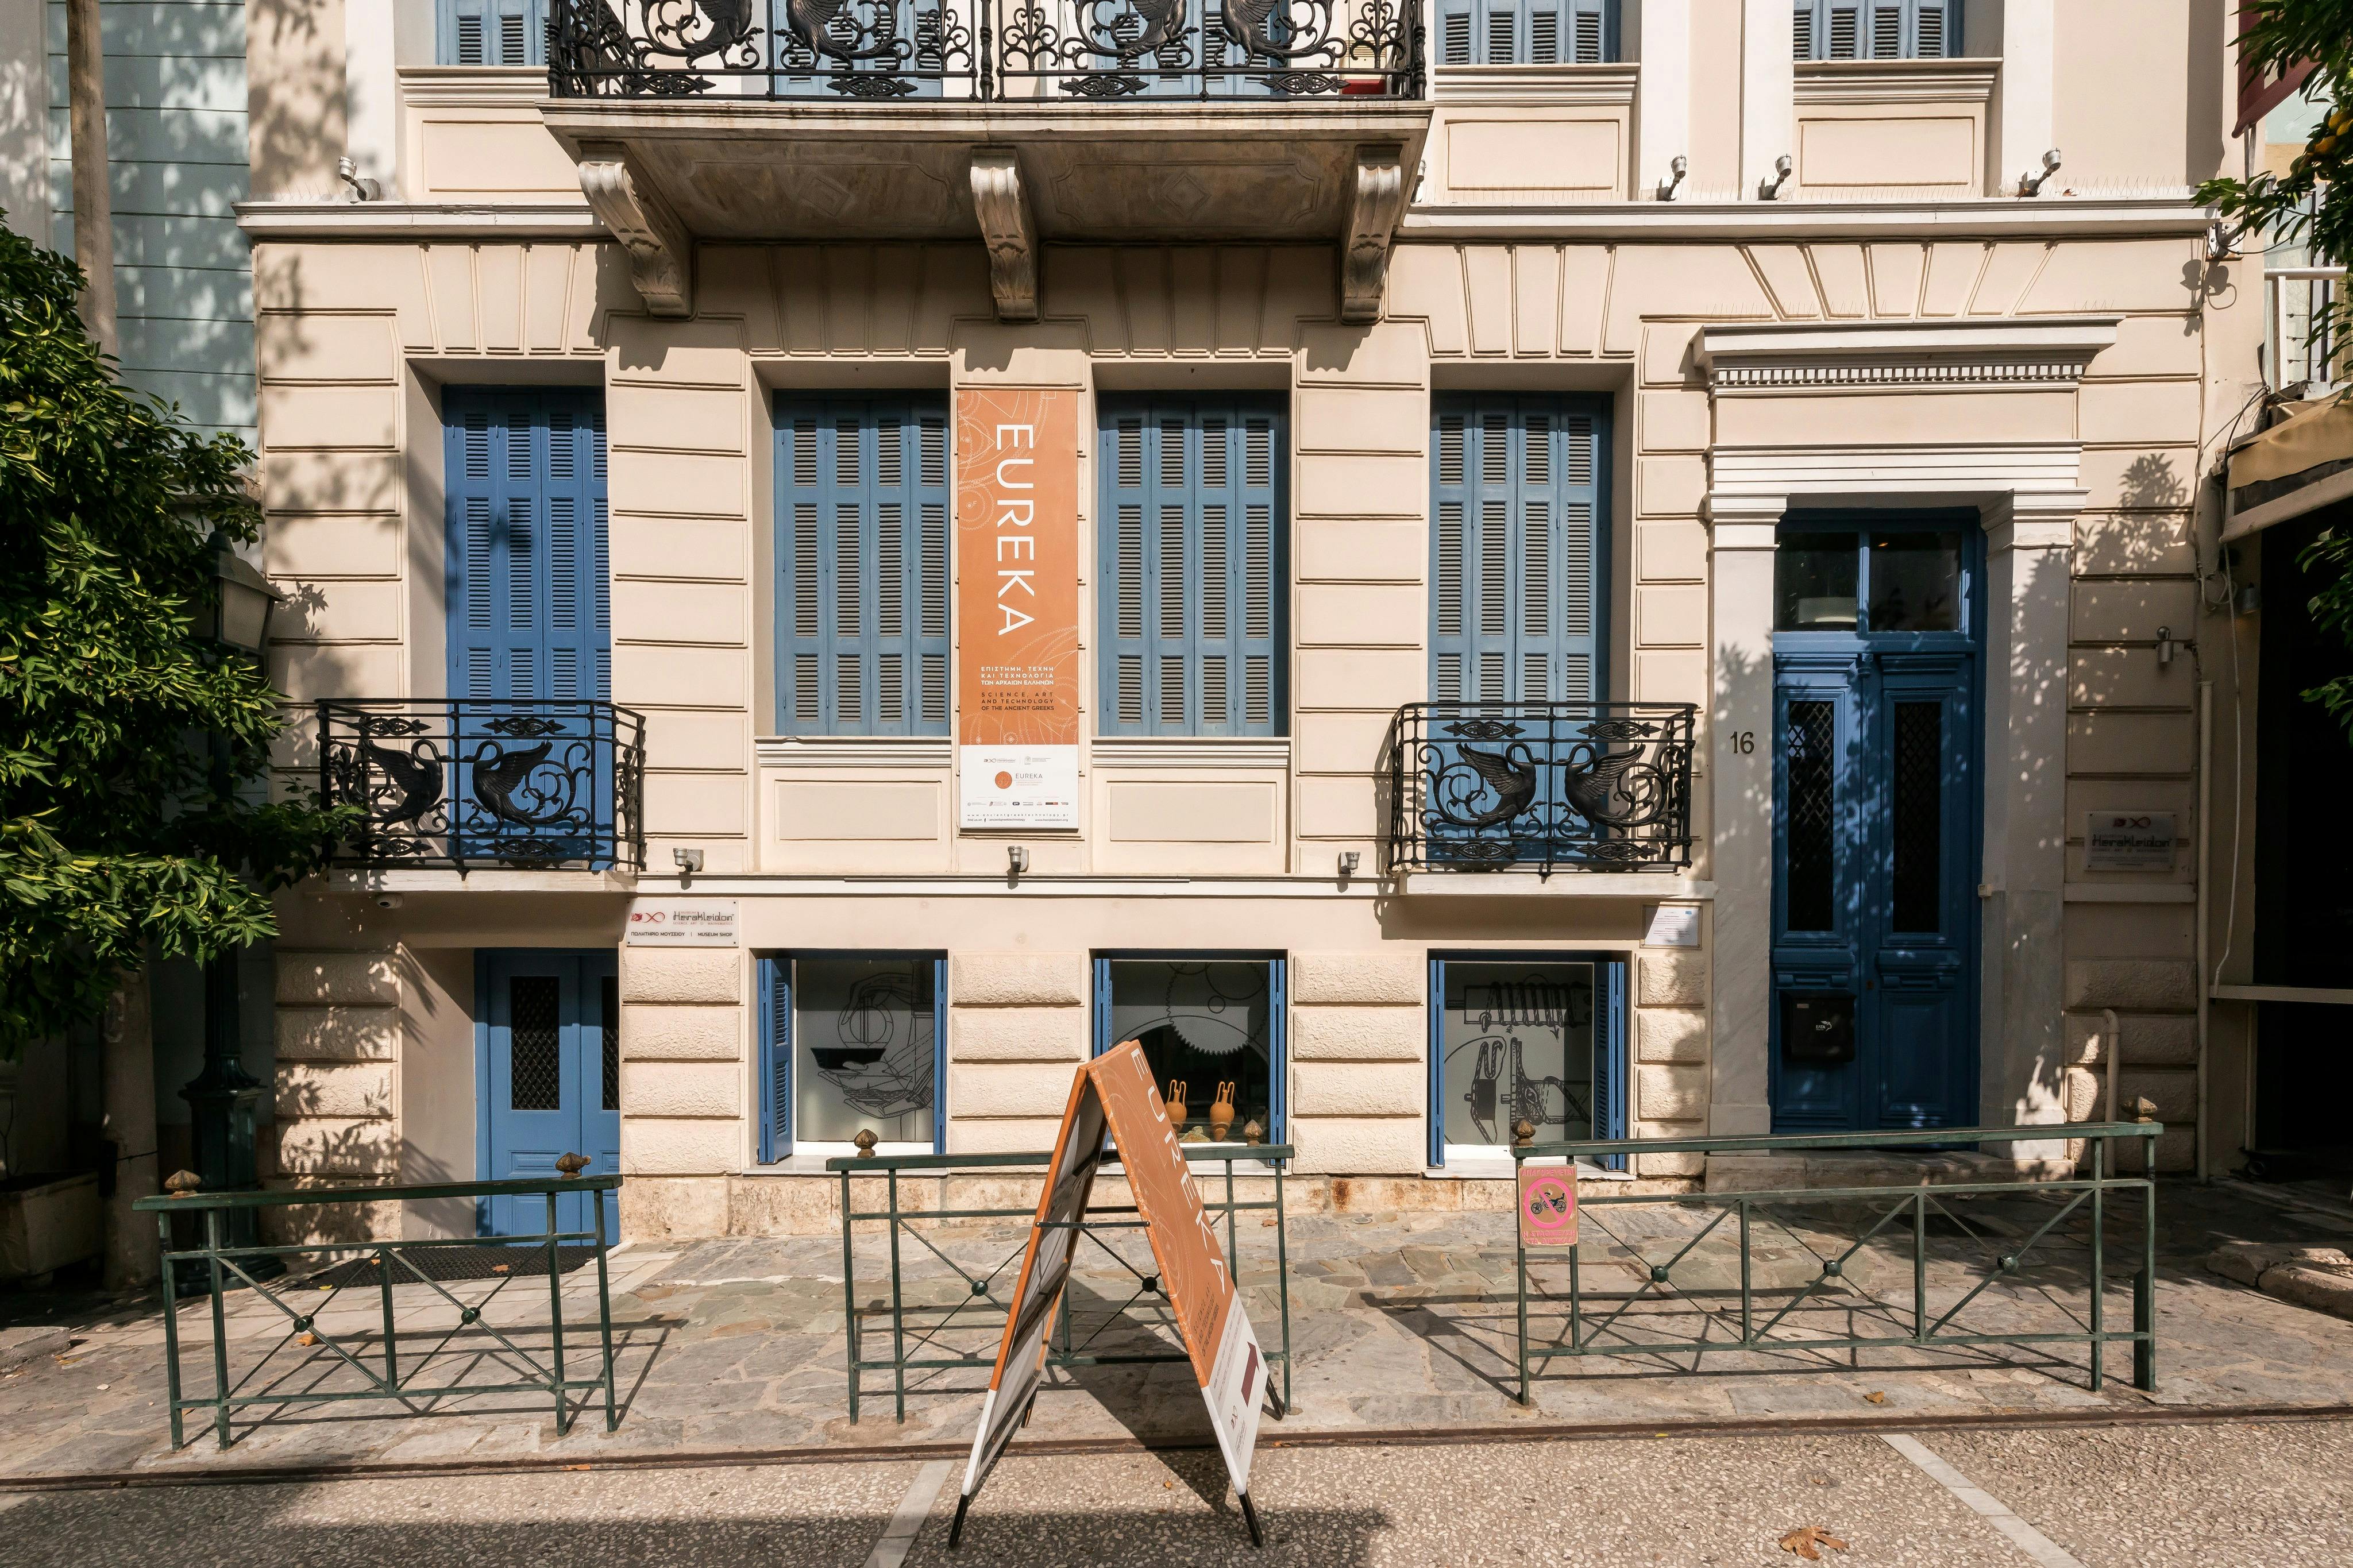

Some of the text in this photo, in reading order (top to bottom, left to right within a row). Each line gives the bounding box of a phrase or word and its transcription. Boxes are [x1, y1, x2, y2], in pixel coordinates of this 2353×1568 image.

[996, 424, 1035, 636] EUREKA
[1730, 731, 1754, 754] 16
[1131, 1048, 1225, 1296] EUREKA
